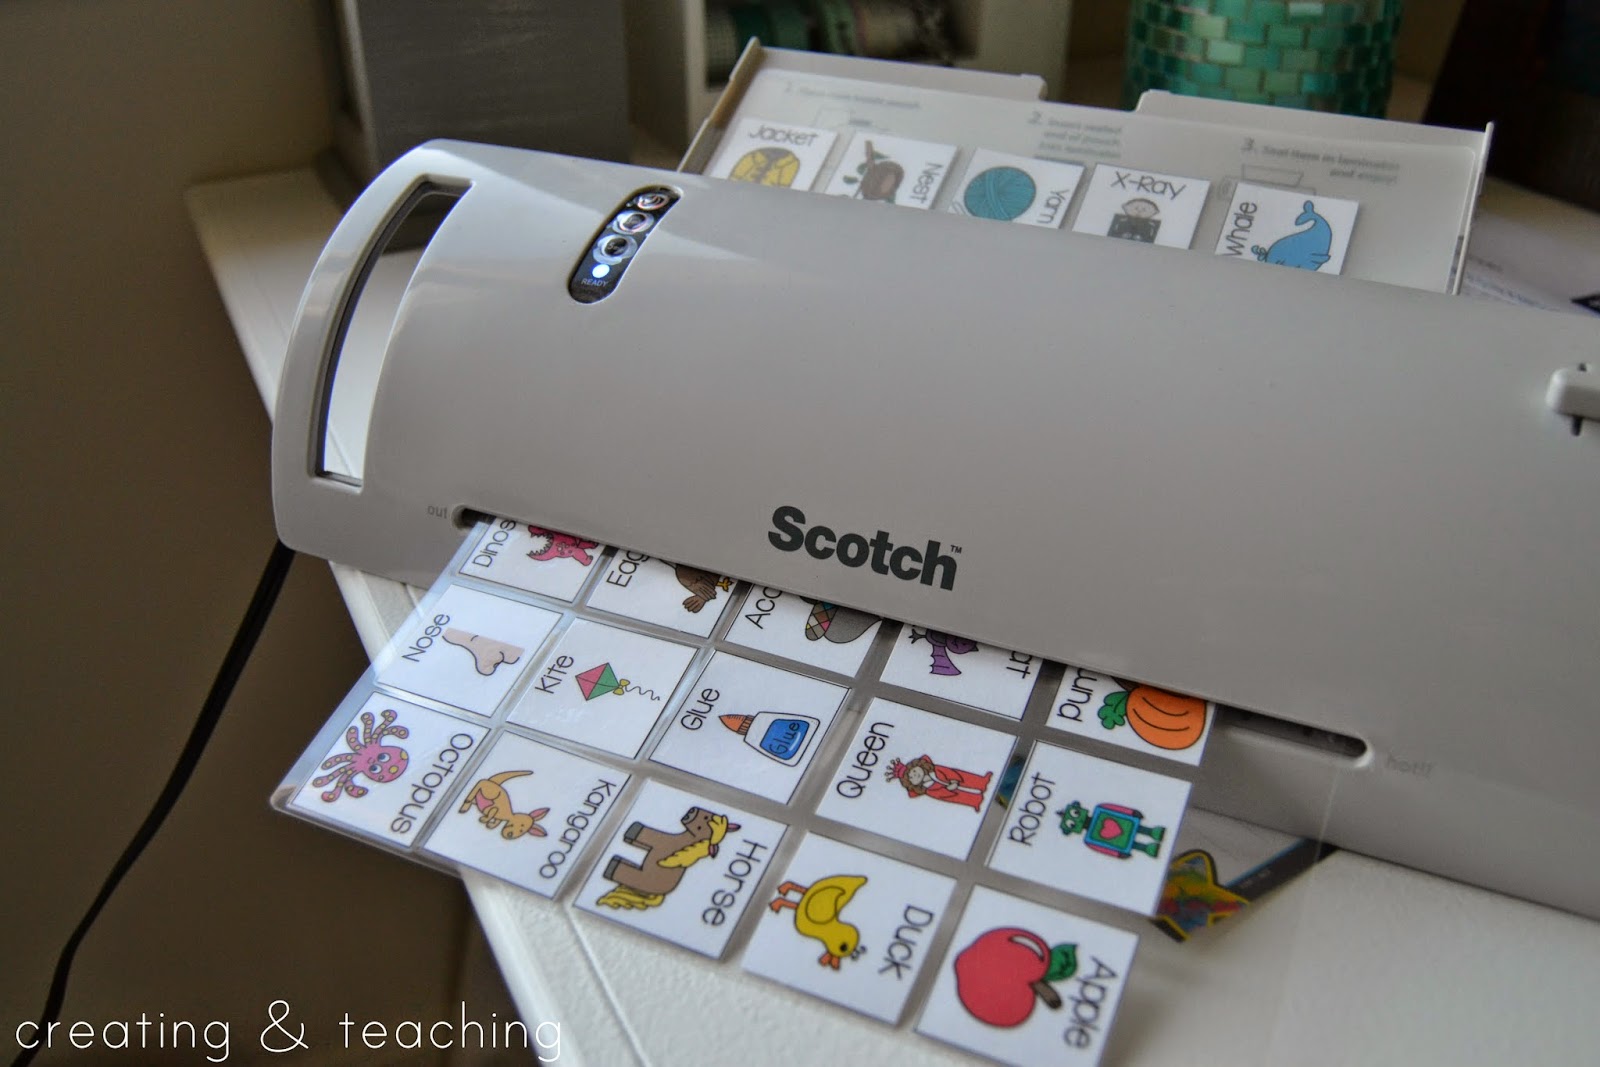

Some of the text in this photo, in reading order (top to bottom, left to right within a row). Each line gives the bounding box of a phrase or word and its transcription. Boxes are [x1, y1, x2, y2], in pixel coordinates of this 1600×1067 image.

[749, 123, 819, 147] Jacket
[910, 161, 945, 204] Nest
[1037, 188, 1070, 224] Yarn
[1110, 170, 1187, 200] X-Ray
[1225, 201, 1258, 257] Whale
[581, 277, 608, 287] READY
[427, 504, 448, 519] out
[768, 505, 958, 592] Scotch
[401, 613, 451, 663] Nose
[534, 654, 575, 695] Kite
[680, 687, 720, 731] Glue
[769, 721, 800, 755] Glue
[836, 721, 895, 799] Queen
[391, 733, 474, 835] Octopus
[1009, 771, 1056, 847] Robot
[539, 778, 617, 879] Kangaroo
[702, 839, 767, 927] Horse
[877, 904, 934, 981] Duck
[1063, 955, 1119, 1050] Apple
